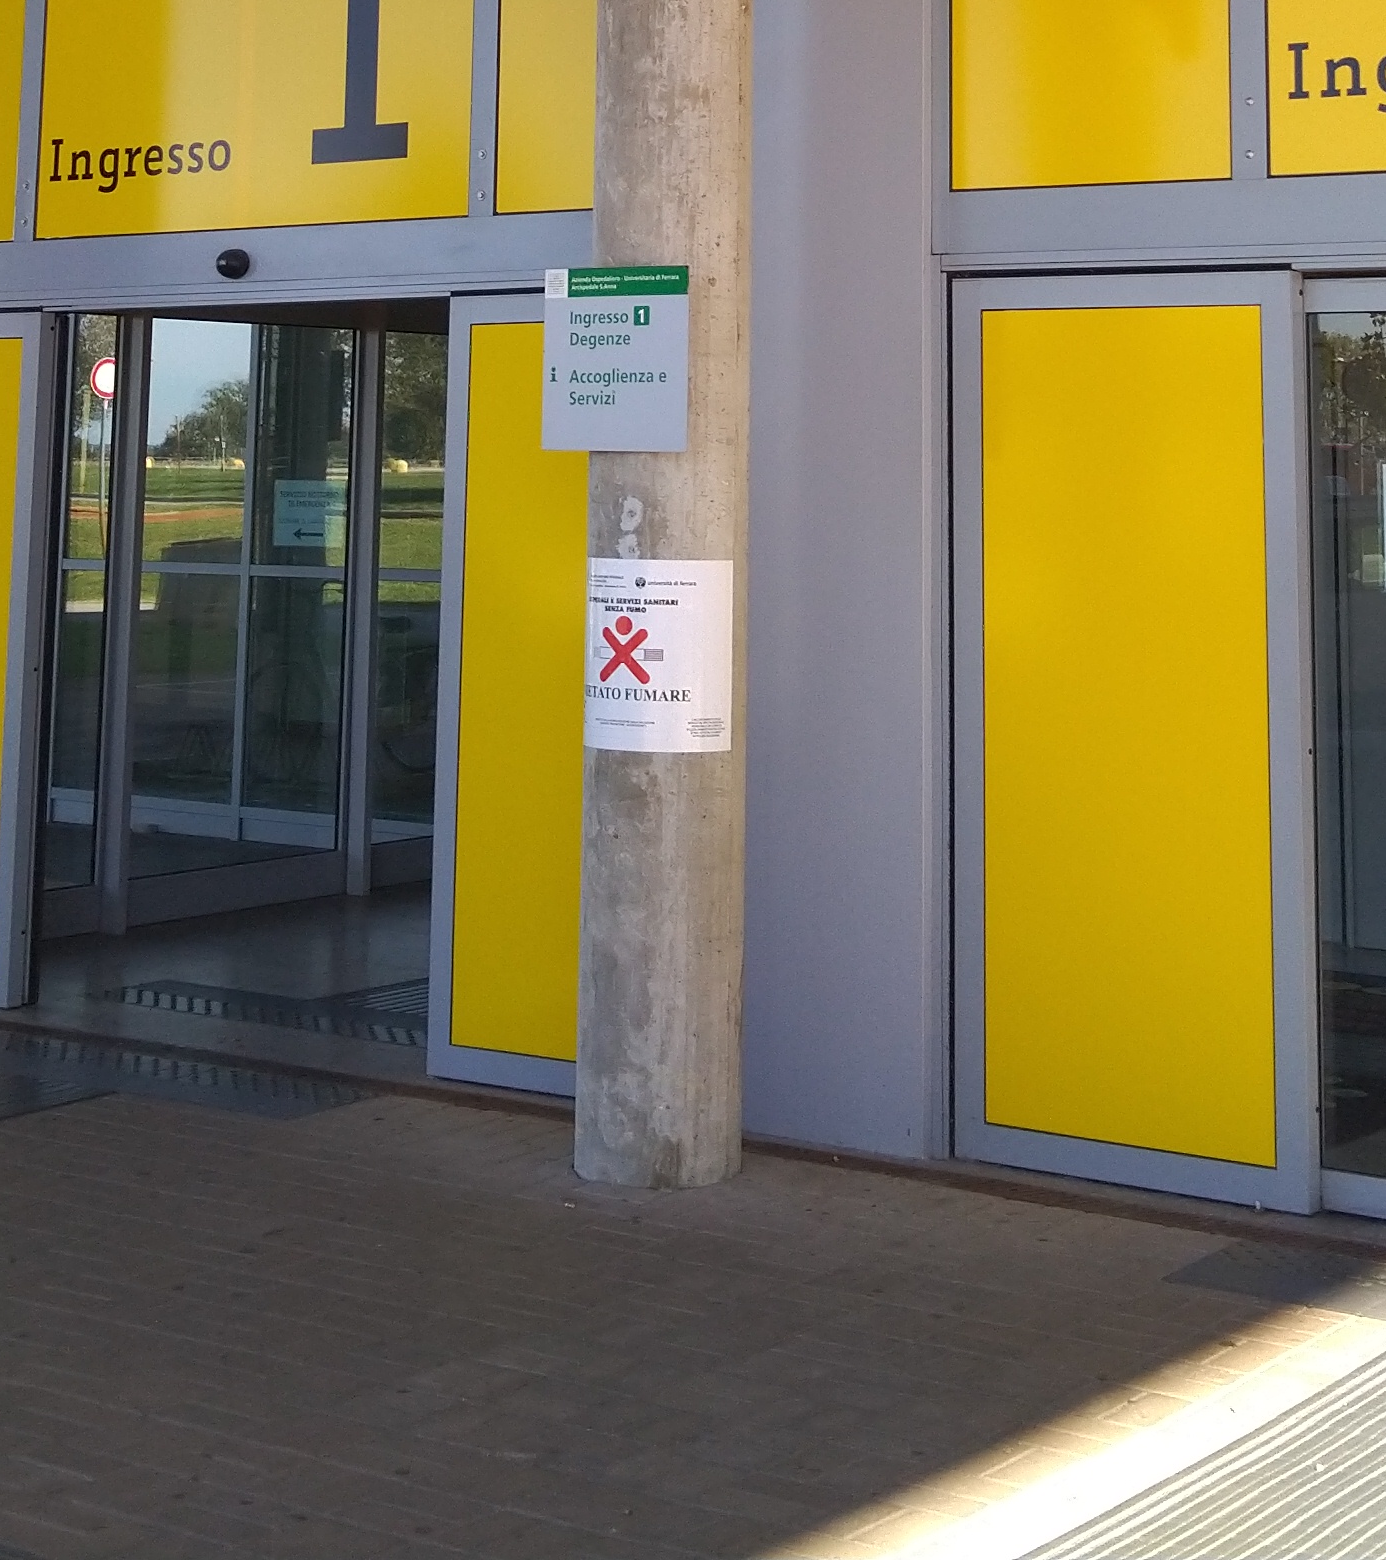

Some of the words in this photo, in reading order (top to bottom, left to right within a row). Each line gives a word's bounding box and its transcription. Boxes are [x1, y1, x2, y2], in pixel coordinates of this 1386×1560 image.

[49, 139, 232, 193] Ingresso
[569, 311, 629, 328] Ingresso
[569, 332, 631, 349] Degenze
[569, 369, 654, 387] Accoglienza
[658, 371, 667, 383] e
[569, 391, 616, 406] Servizi
[604, 605, 625, 613] SENZA
[643, 598, 679, 606] SANITARI
[625, 688, 691, 702] FUMARE
